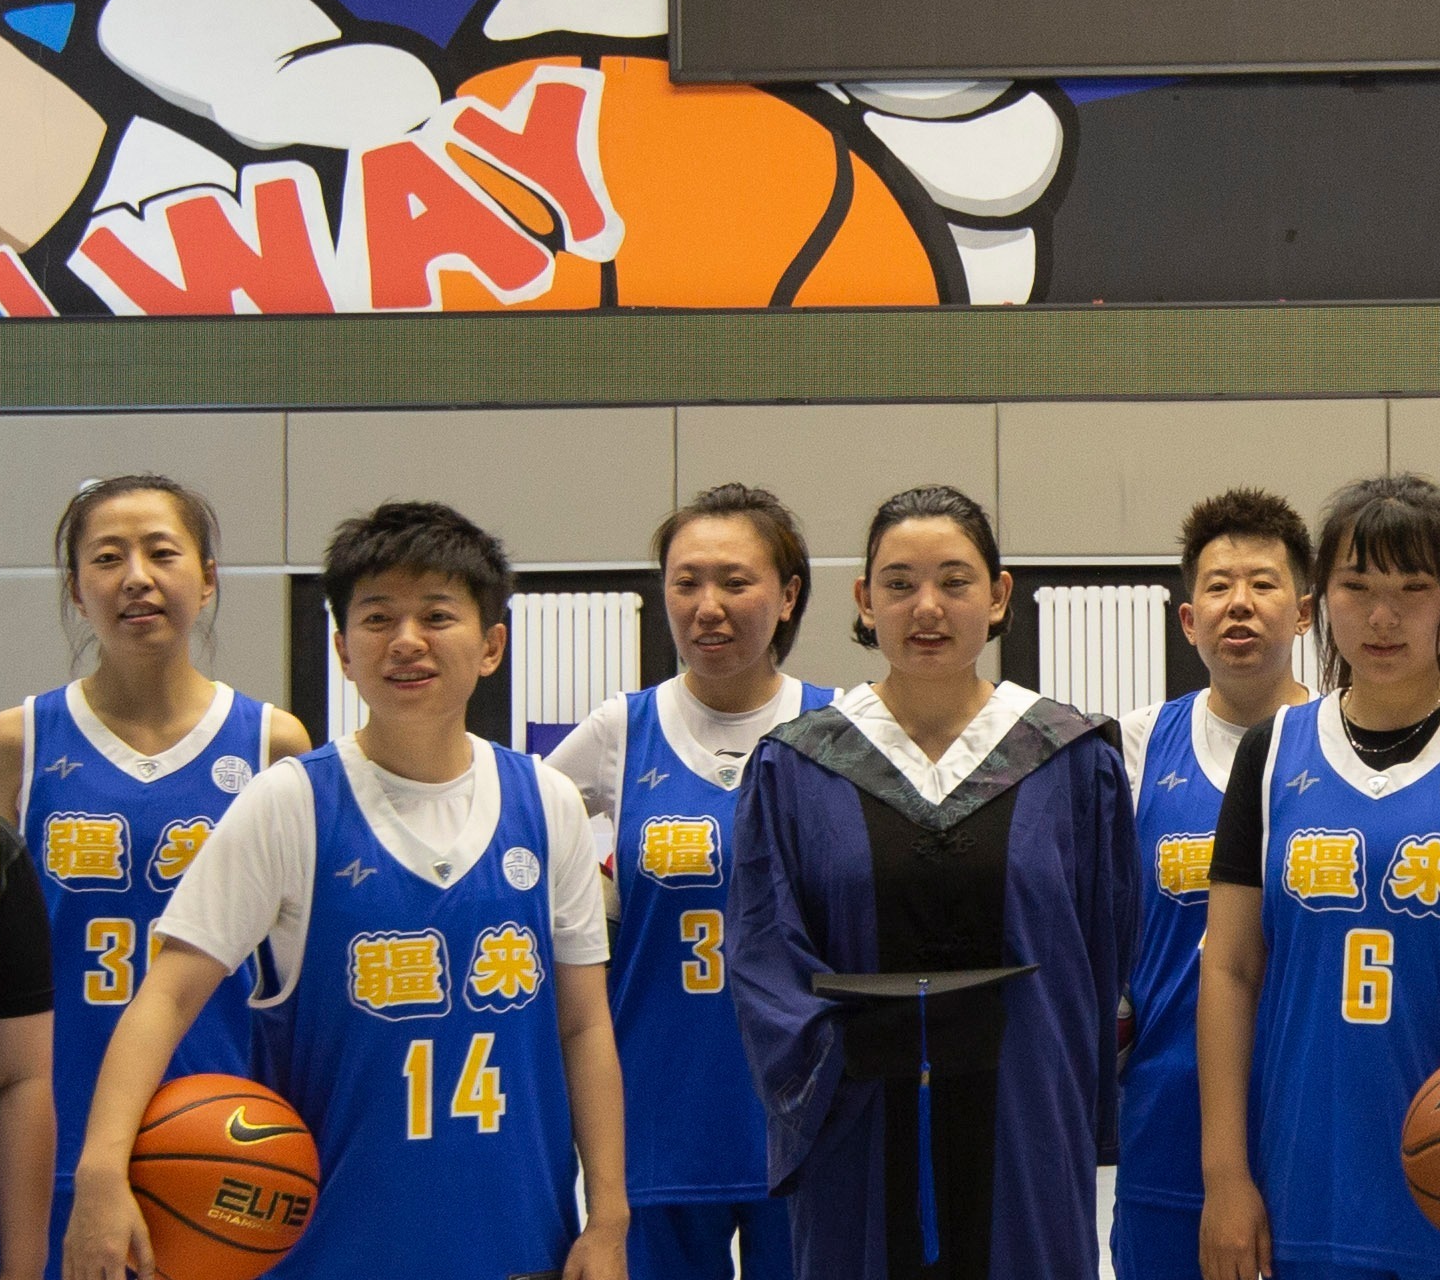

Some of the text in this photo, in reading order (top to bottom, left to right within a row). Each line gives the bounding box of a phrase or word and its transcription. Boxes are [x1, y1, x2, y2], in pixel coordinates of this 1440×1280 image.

[353, 928, 538, 1009] 疆来
[1342, 929, 1394, 1025] 6
[404, 1032, 506, 1140] 14
